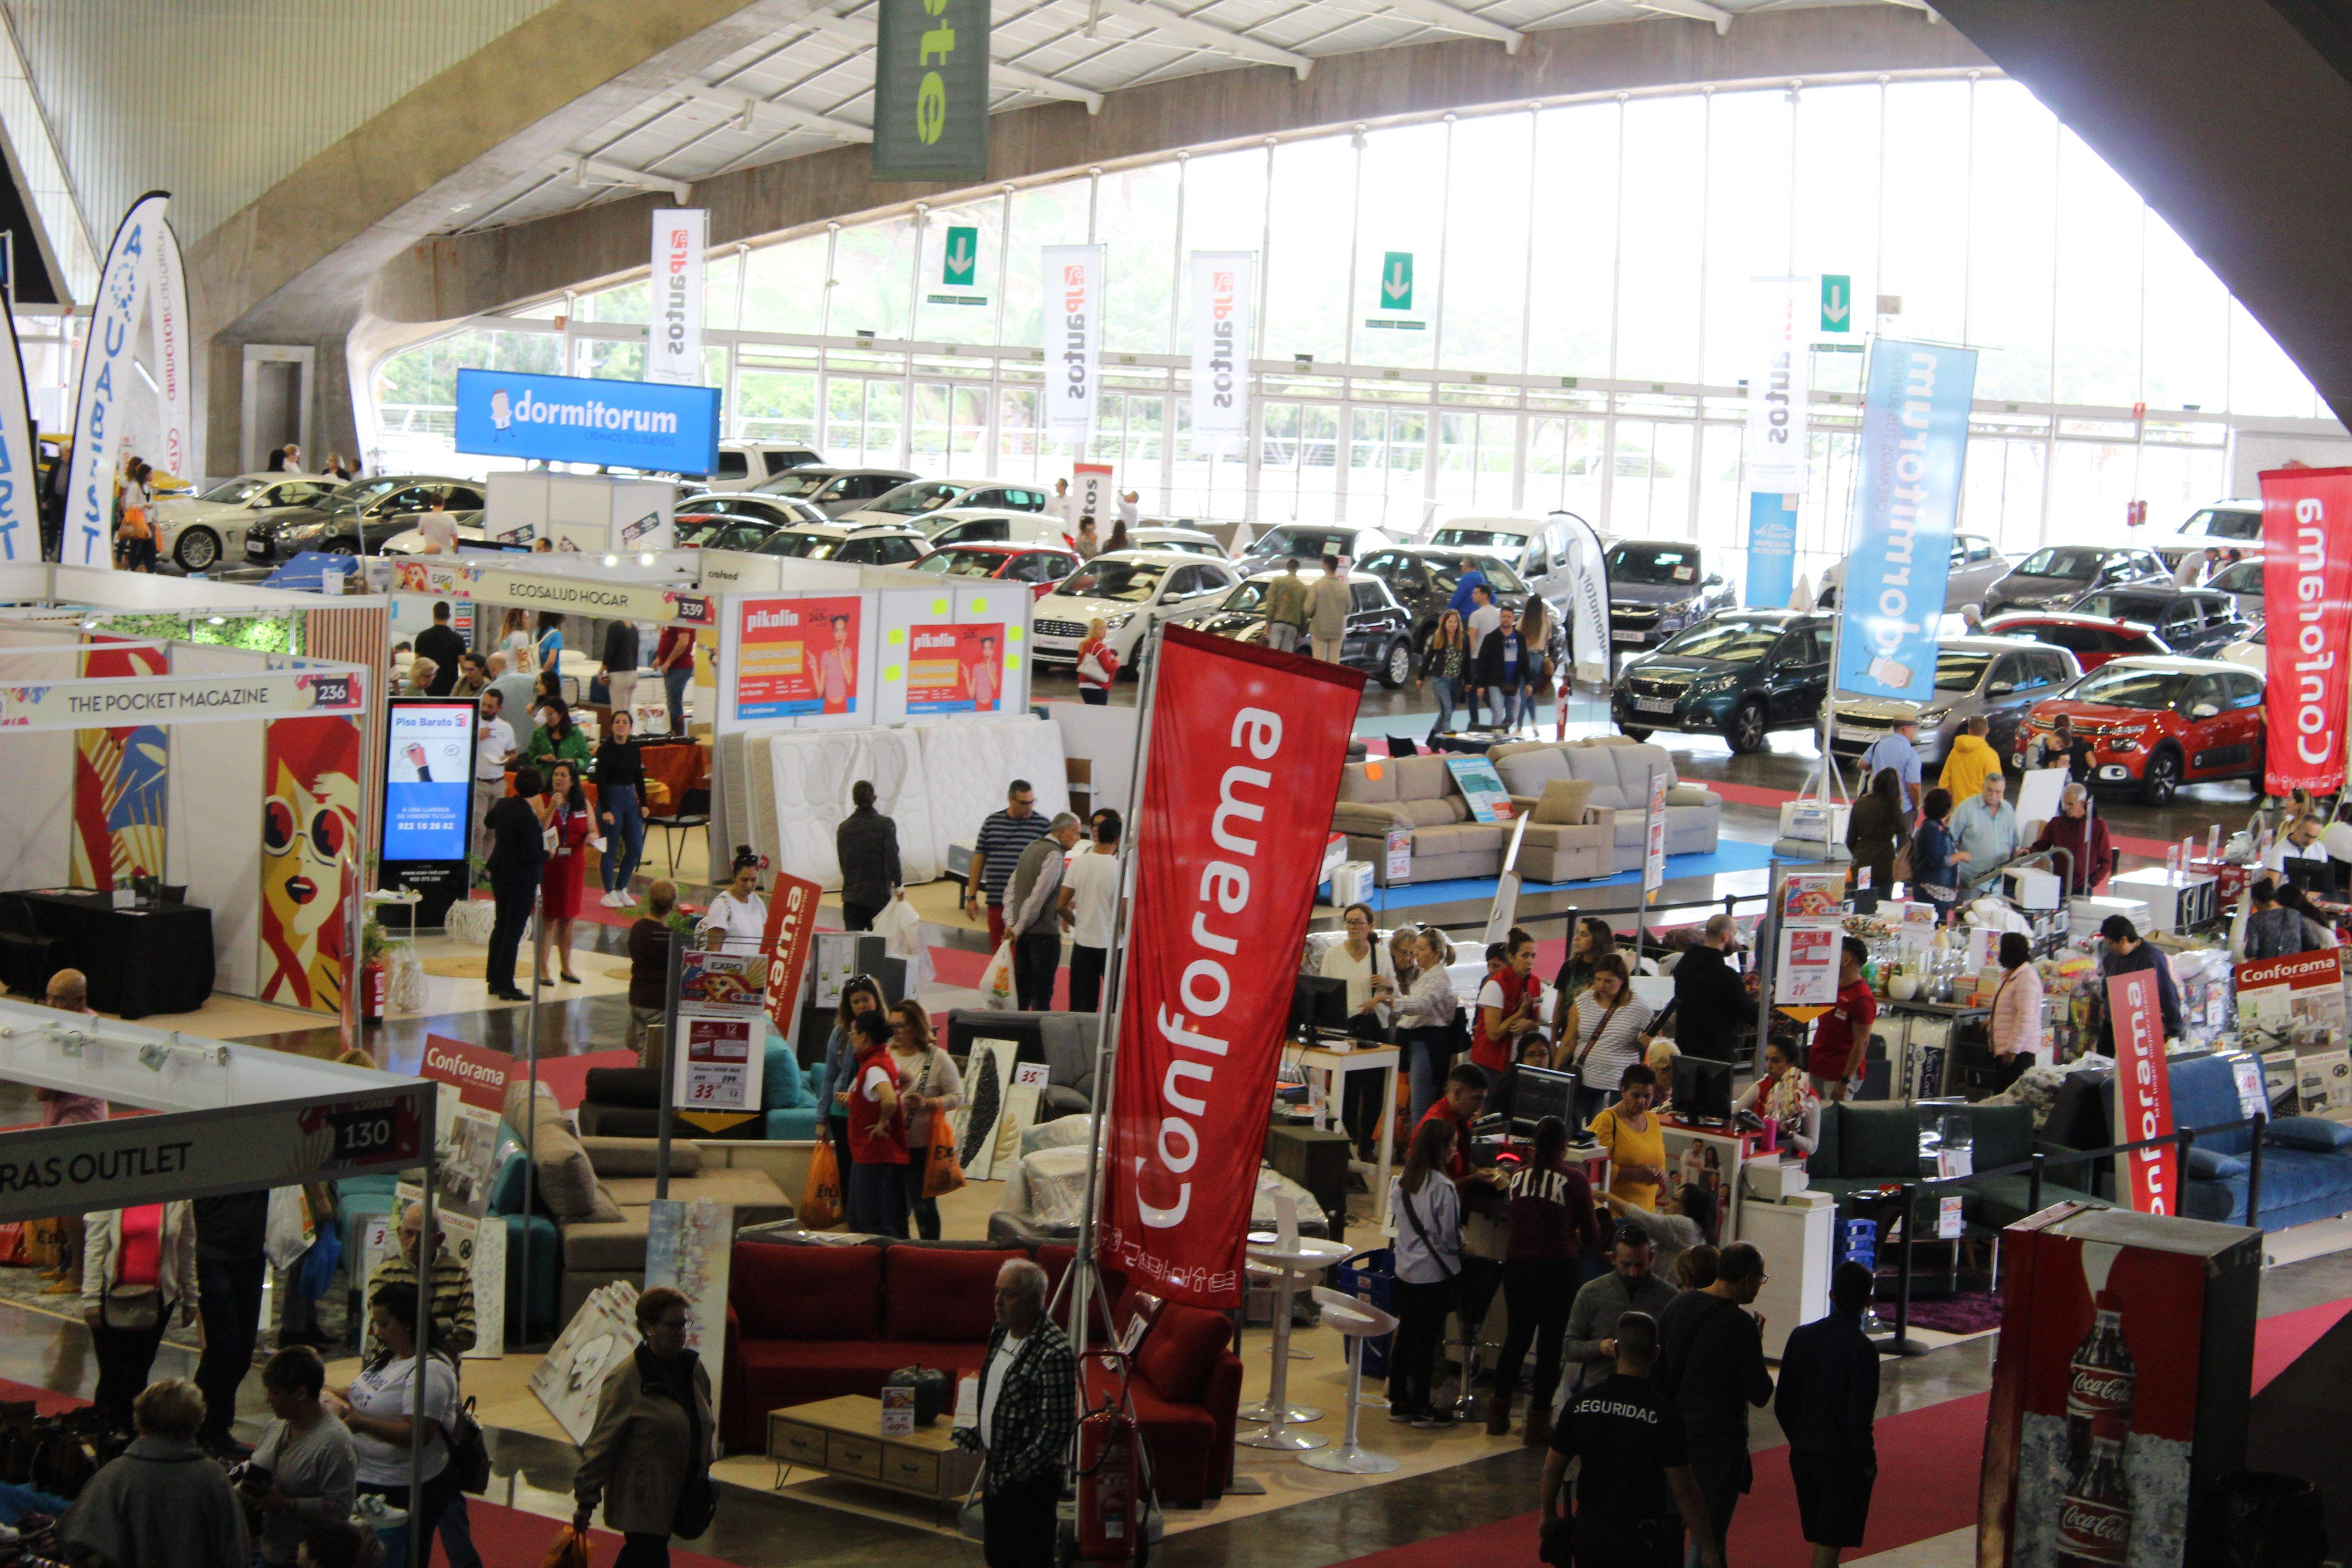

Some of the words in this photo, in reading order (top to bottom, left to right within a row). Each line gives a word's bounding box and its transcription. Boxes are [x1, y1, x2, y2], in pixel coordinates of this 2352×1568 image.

[916, 0, 956, 145] te
[514, 389, 677, 434] dormitorum
[510, 583, 578, 602] ECOSALUD
[579, 591, 629, 607] HOGAR
[681, 603, 704, 617] 339
[746, 609, 799, 633] pikolin
[913, 633, 956, 652] pikolin
[69, 695, 104, 713] THE
[106, 691, 177, 711] POCKET
[180, 686, 269, 708] MAGAZINE
[318, 684, 347, 700] 236
[396, 717, 416, 726] Piso
[419, 717, 453, 727] Barato
[710, 961, 743, 972] EXPO
[1134, 704, 1284, 1228] Conforama
[2240, 957, 2336, 983] Conforama
[426, 1047, 505, 1086] Conforama
[344, 1119, 391, 1149] 130
[69, 1142, 192, 1181] OUTLET
